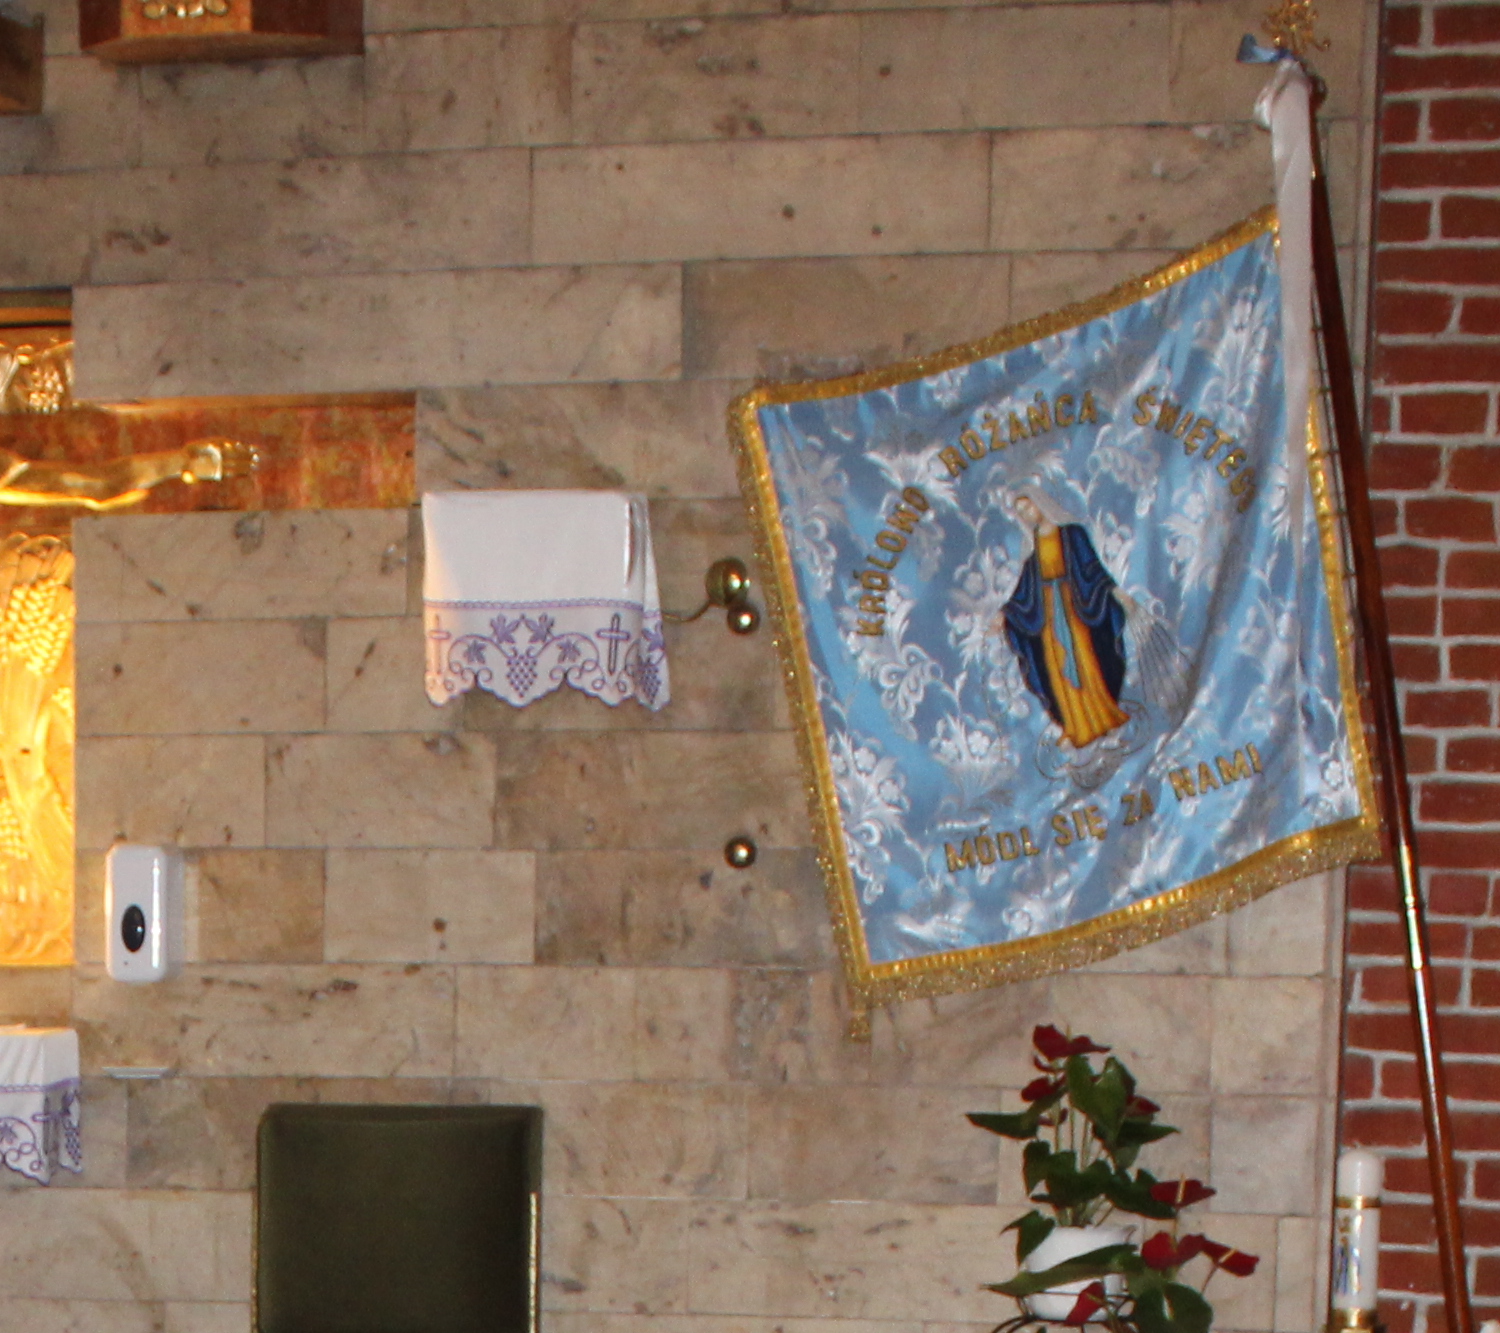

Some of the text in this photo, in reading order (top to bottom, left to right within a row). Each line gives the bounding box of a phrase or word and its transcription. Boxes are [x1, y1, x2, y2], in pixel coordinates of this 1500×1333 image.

[854, 486, 930, 636] KRÓLOWO
[938, 390, 1098, 477] RÓŻAŃCA
[944, 742, 1263, 872] MÓDL SIĘ ZA NAMI
